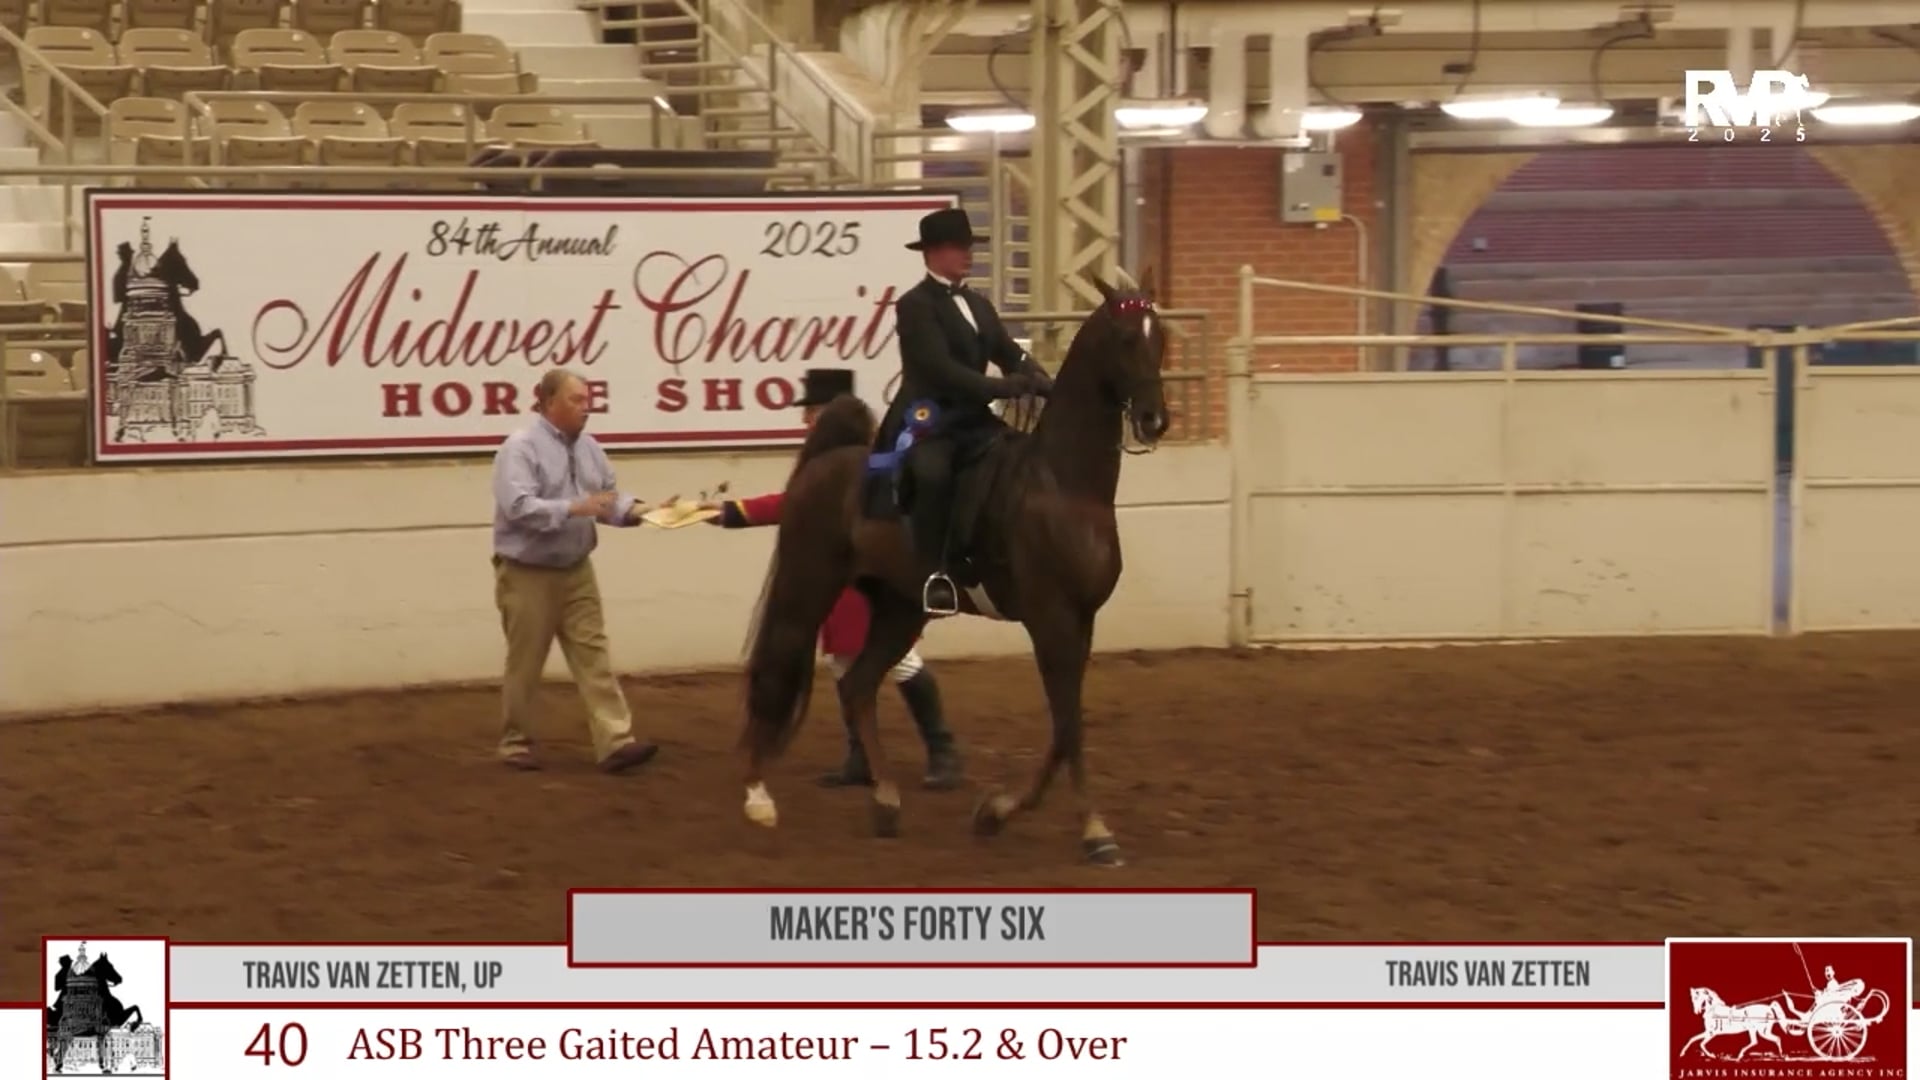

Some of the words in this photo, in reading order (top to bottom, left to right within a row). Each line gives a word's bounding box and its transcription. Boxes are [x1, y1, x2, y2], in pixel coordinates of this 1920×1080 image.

[427, 217, 500, 257] 84th
[498, 224, 618, 261] Annual
[759, 221, 862, 257] 2025
[253, 251, 622, 370] Midwest
[633, 251, 903, 404] Charit
[381, 380, 609, 418] HORE
[655, 376, 807, 413] SHO
